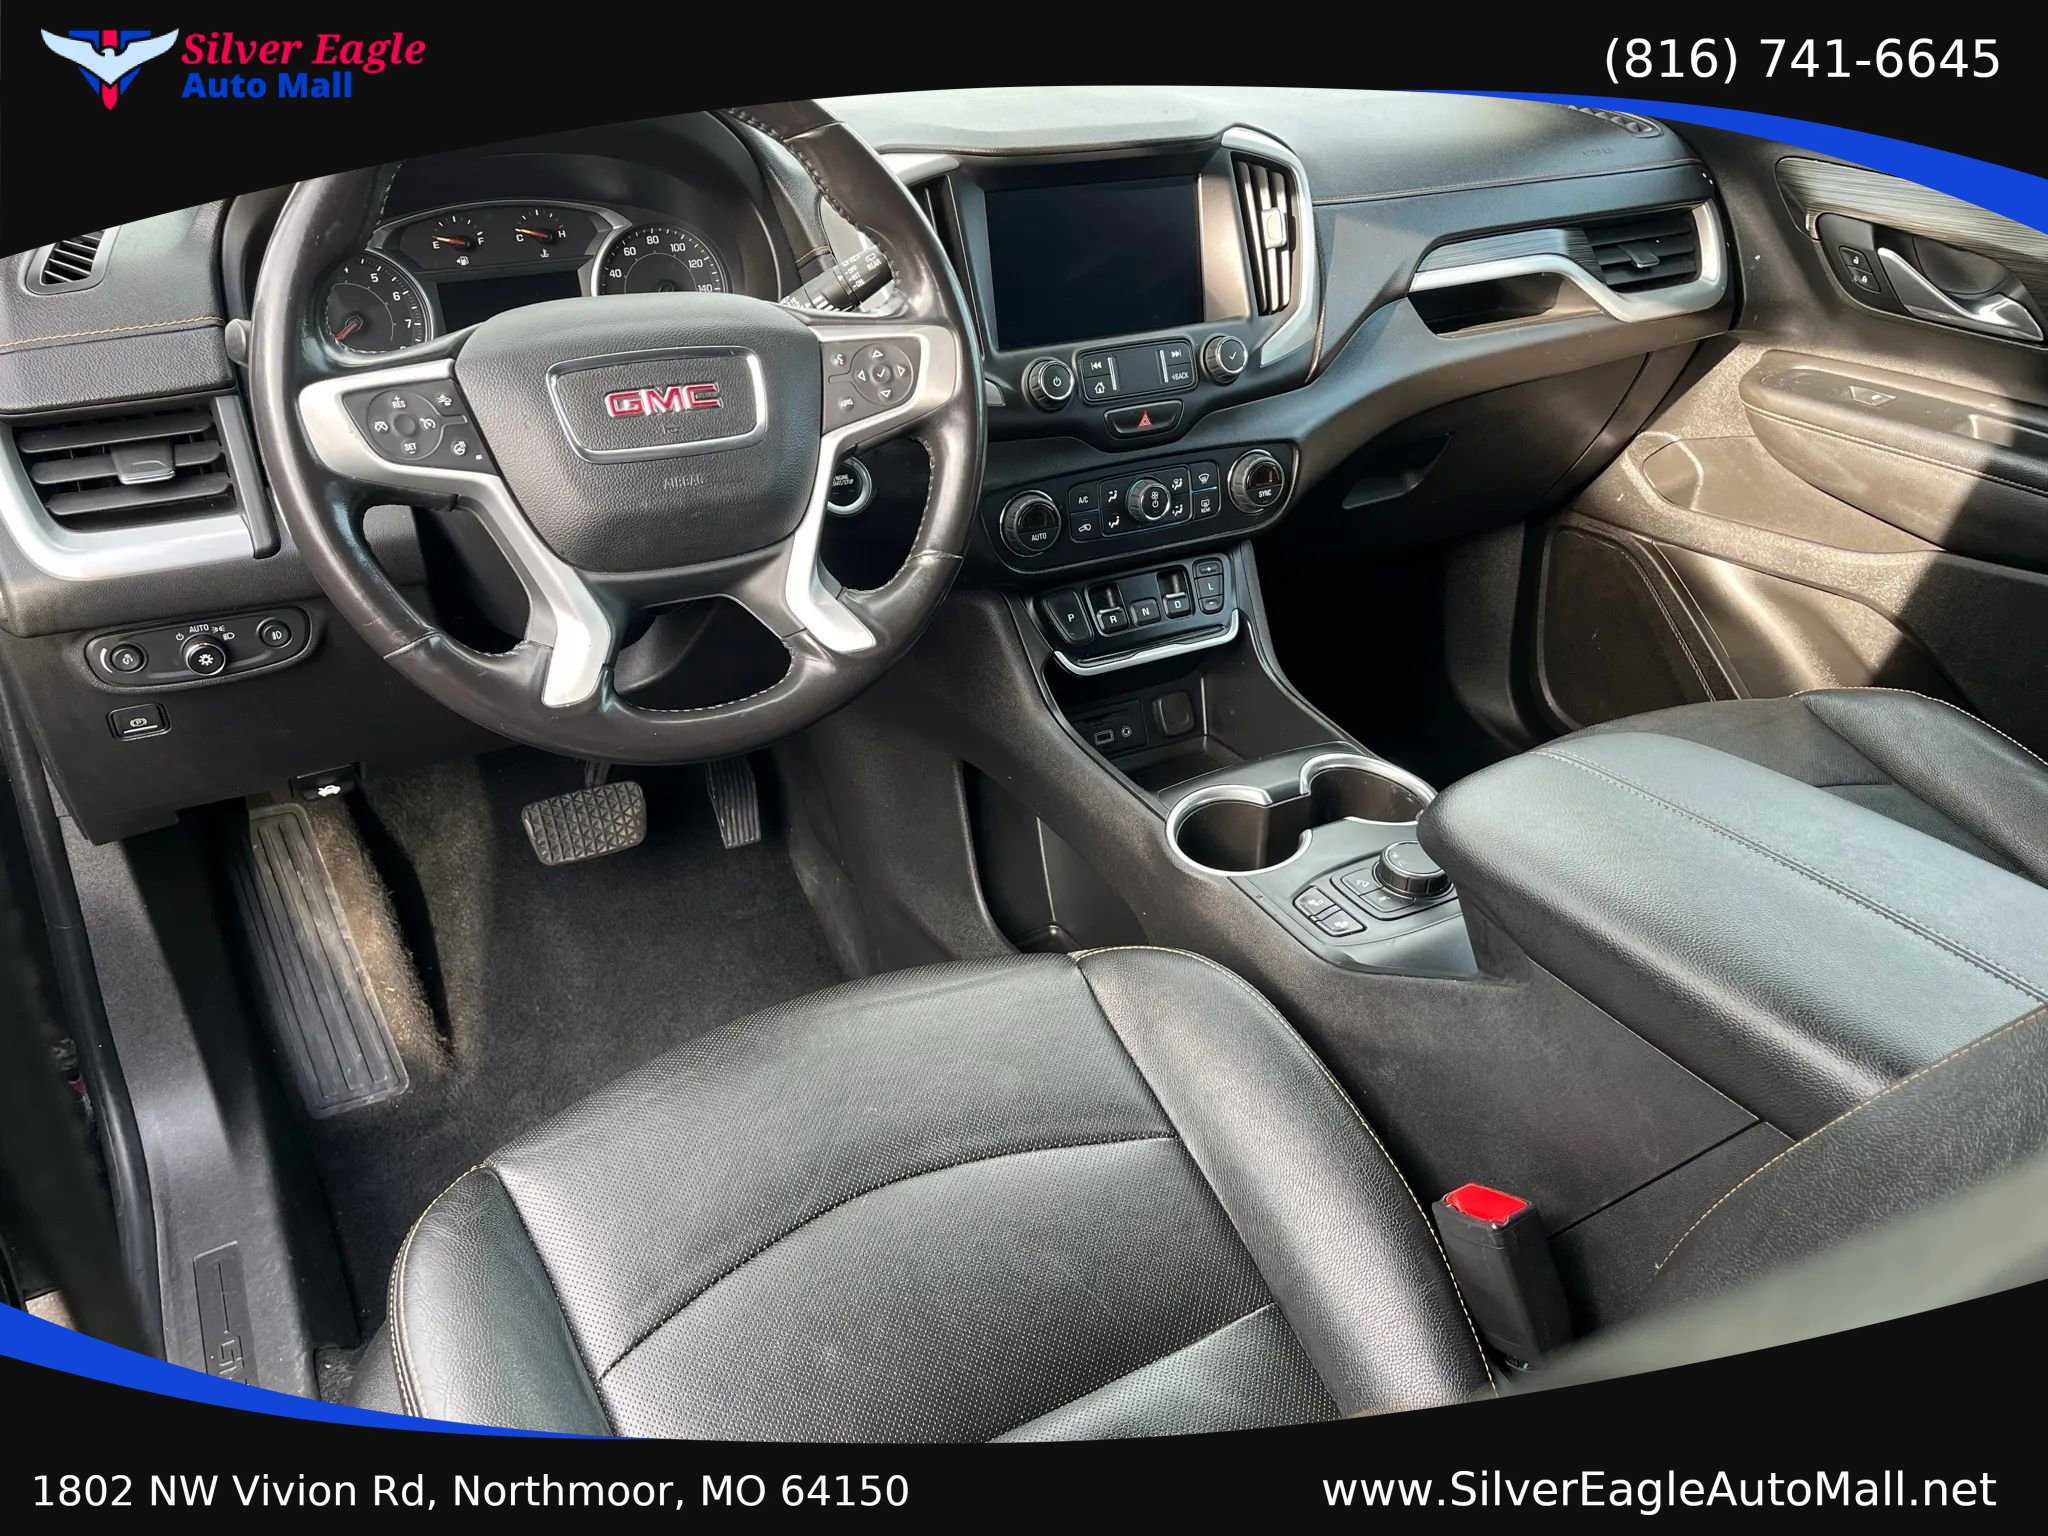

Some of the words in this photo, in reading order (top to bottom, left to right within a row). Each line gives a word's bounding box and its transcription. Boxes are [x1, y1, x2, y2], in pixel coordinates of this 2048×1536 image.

[646, 235, 660, 245] 80
[623, 246, 637, 257] 60
[670, 242, 686, 253] 100
[688, 259, 704, 269] 120
[370, 272, 379, 283] 5
[609, 268, 623, 278] 40
[392, 291, 401, 301] 6
[404, 318, 412, 329] 7
[604, 382, 724, 417] GMC
[1258, 488, 1272, 498] SYNC
[1078, 495, 1089, 505] A/C
[1031, 532, 1047, 542] AUTO
[1175, 601, 1182, 609] D
[1142, 608, 1150, 616] N
[1067, 613, 1075, 622] P
[1109, 615, 1118, 624] R
[189, 623, 209, 634] AUTO
